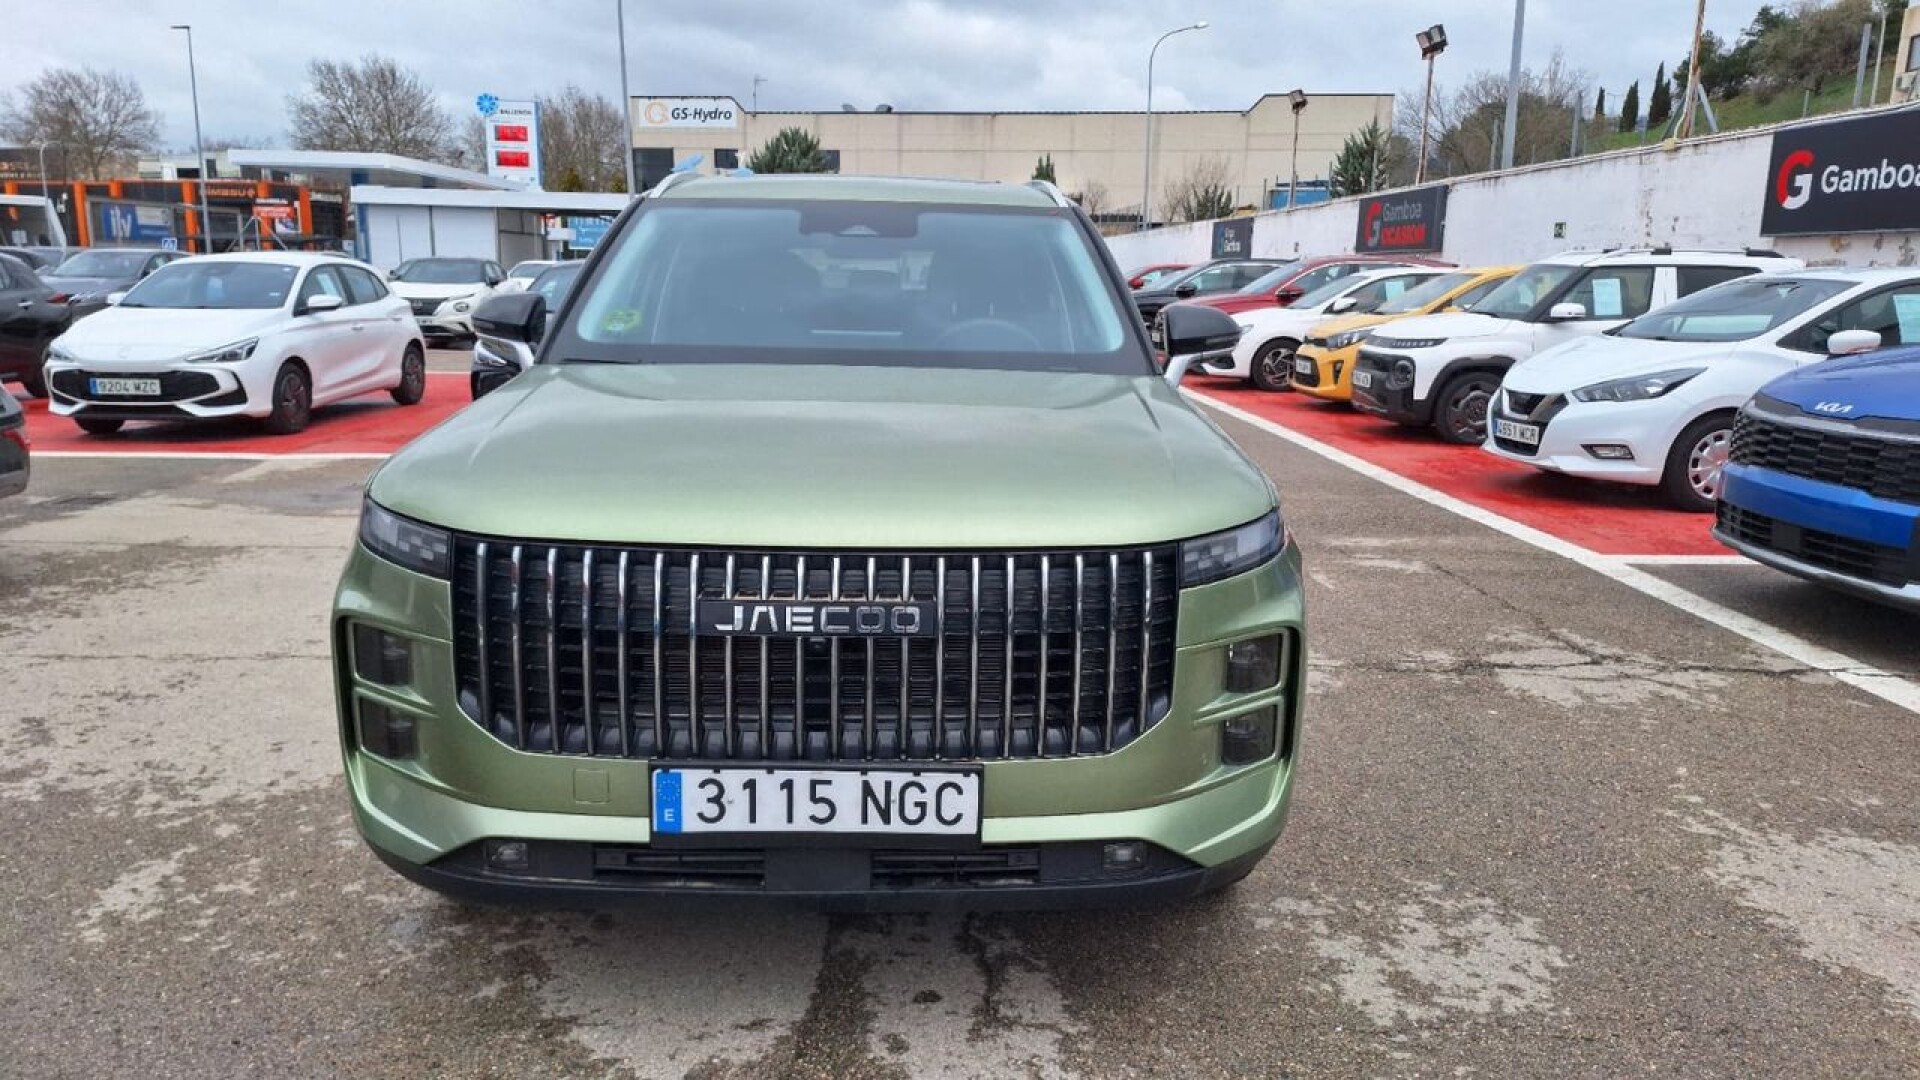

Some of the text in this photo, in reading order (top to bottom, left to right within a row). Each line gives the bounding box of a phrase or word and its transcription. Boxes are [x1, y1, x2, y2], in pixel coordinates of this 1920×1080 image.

[671, 107, 733, 124] GS-Hydro
[1383, 200, 1422, 222] Gamboa
[1814, 401, 1854, 414] KIA
[714, 605, 921, 634] JAECOO
[664, 777, 964, 826] E 3115 NGC
